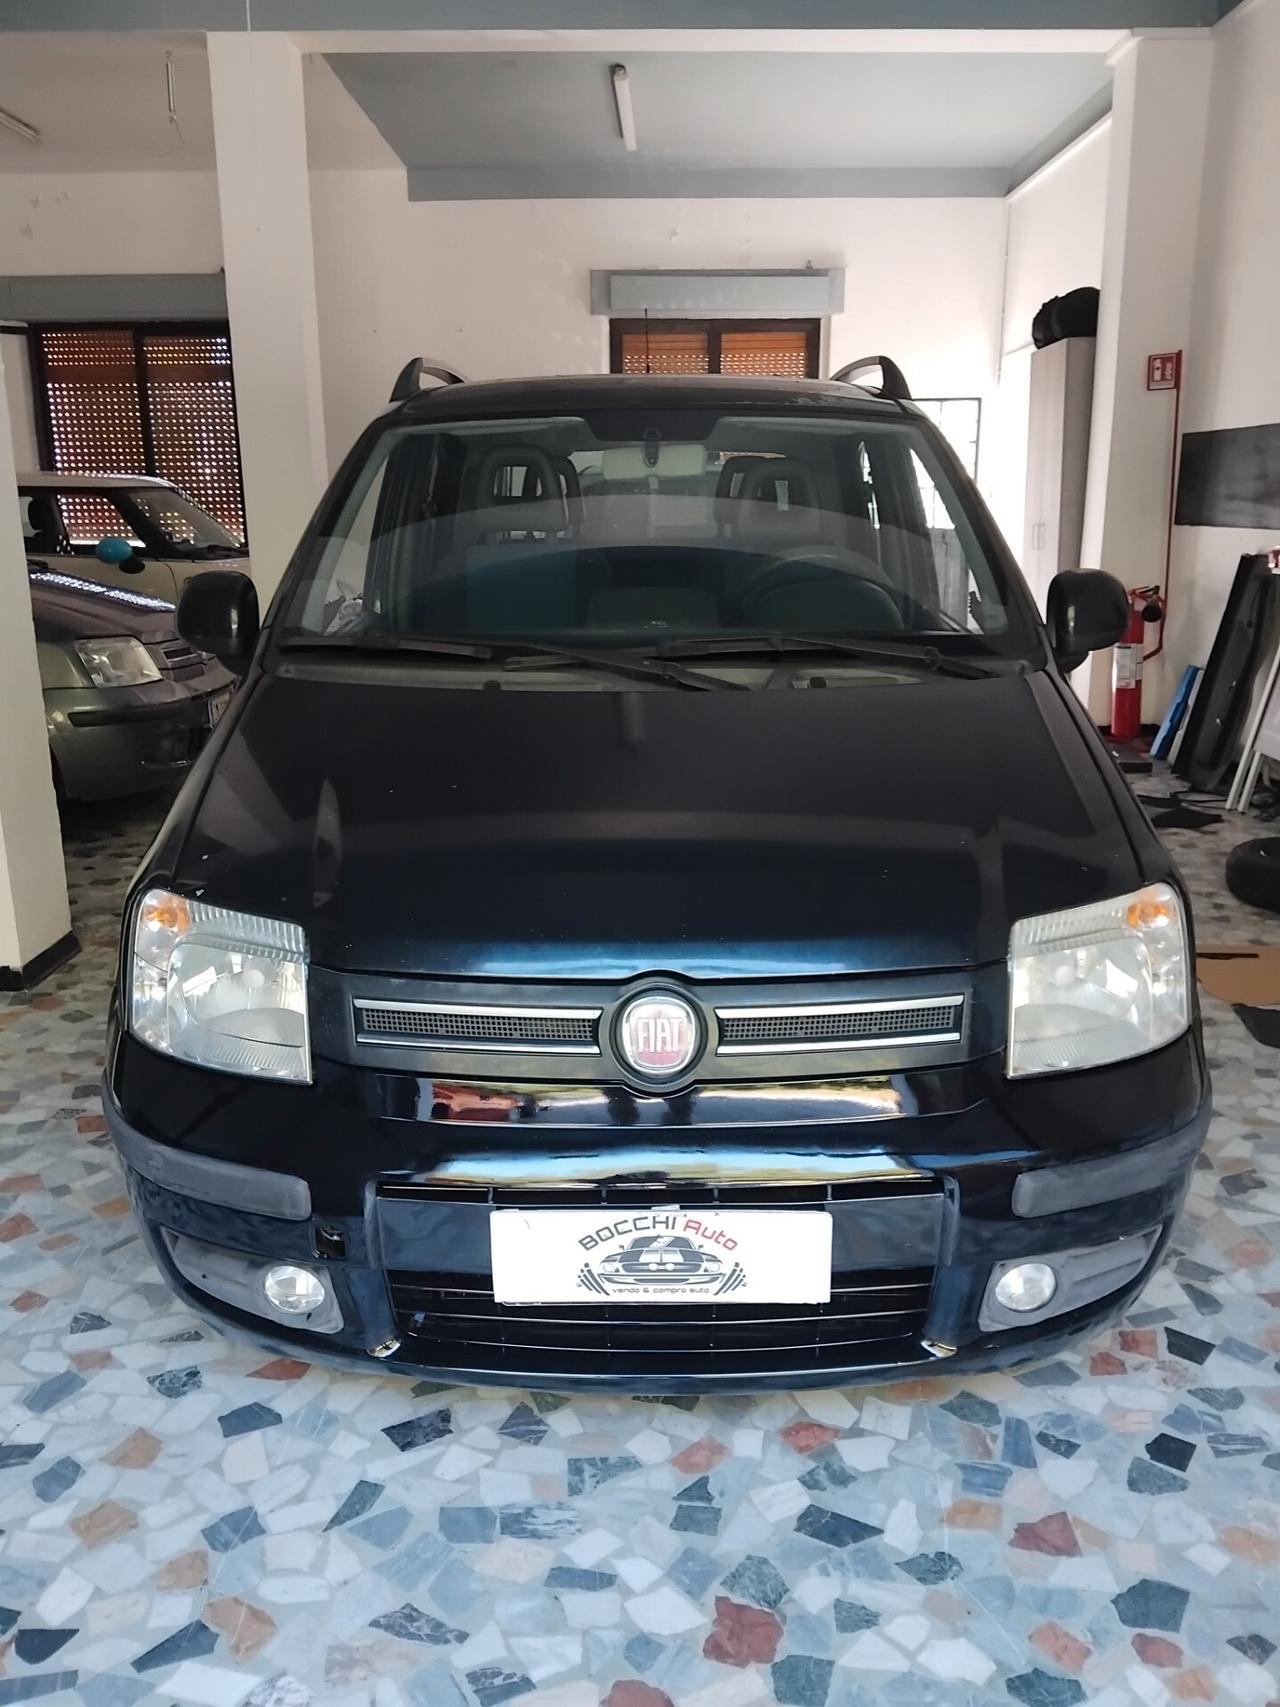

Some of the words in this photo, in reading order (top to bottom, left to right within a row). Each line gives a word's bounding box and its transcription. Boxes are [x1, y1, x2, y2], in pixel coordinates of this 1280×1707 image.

[637, 1017, 683, 1053] FIAT
[578, 1215, 677, 1251] BOCCHI
[683, 1219, 738, 1251] Auto
[652, 1287, 687, 1295] compro
